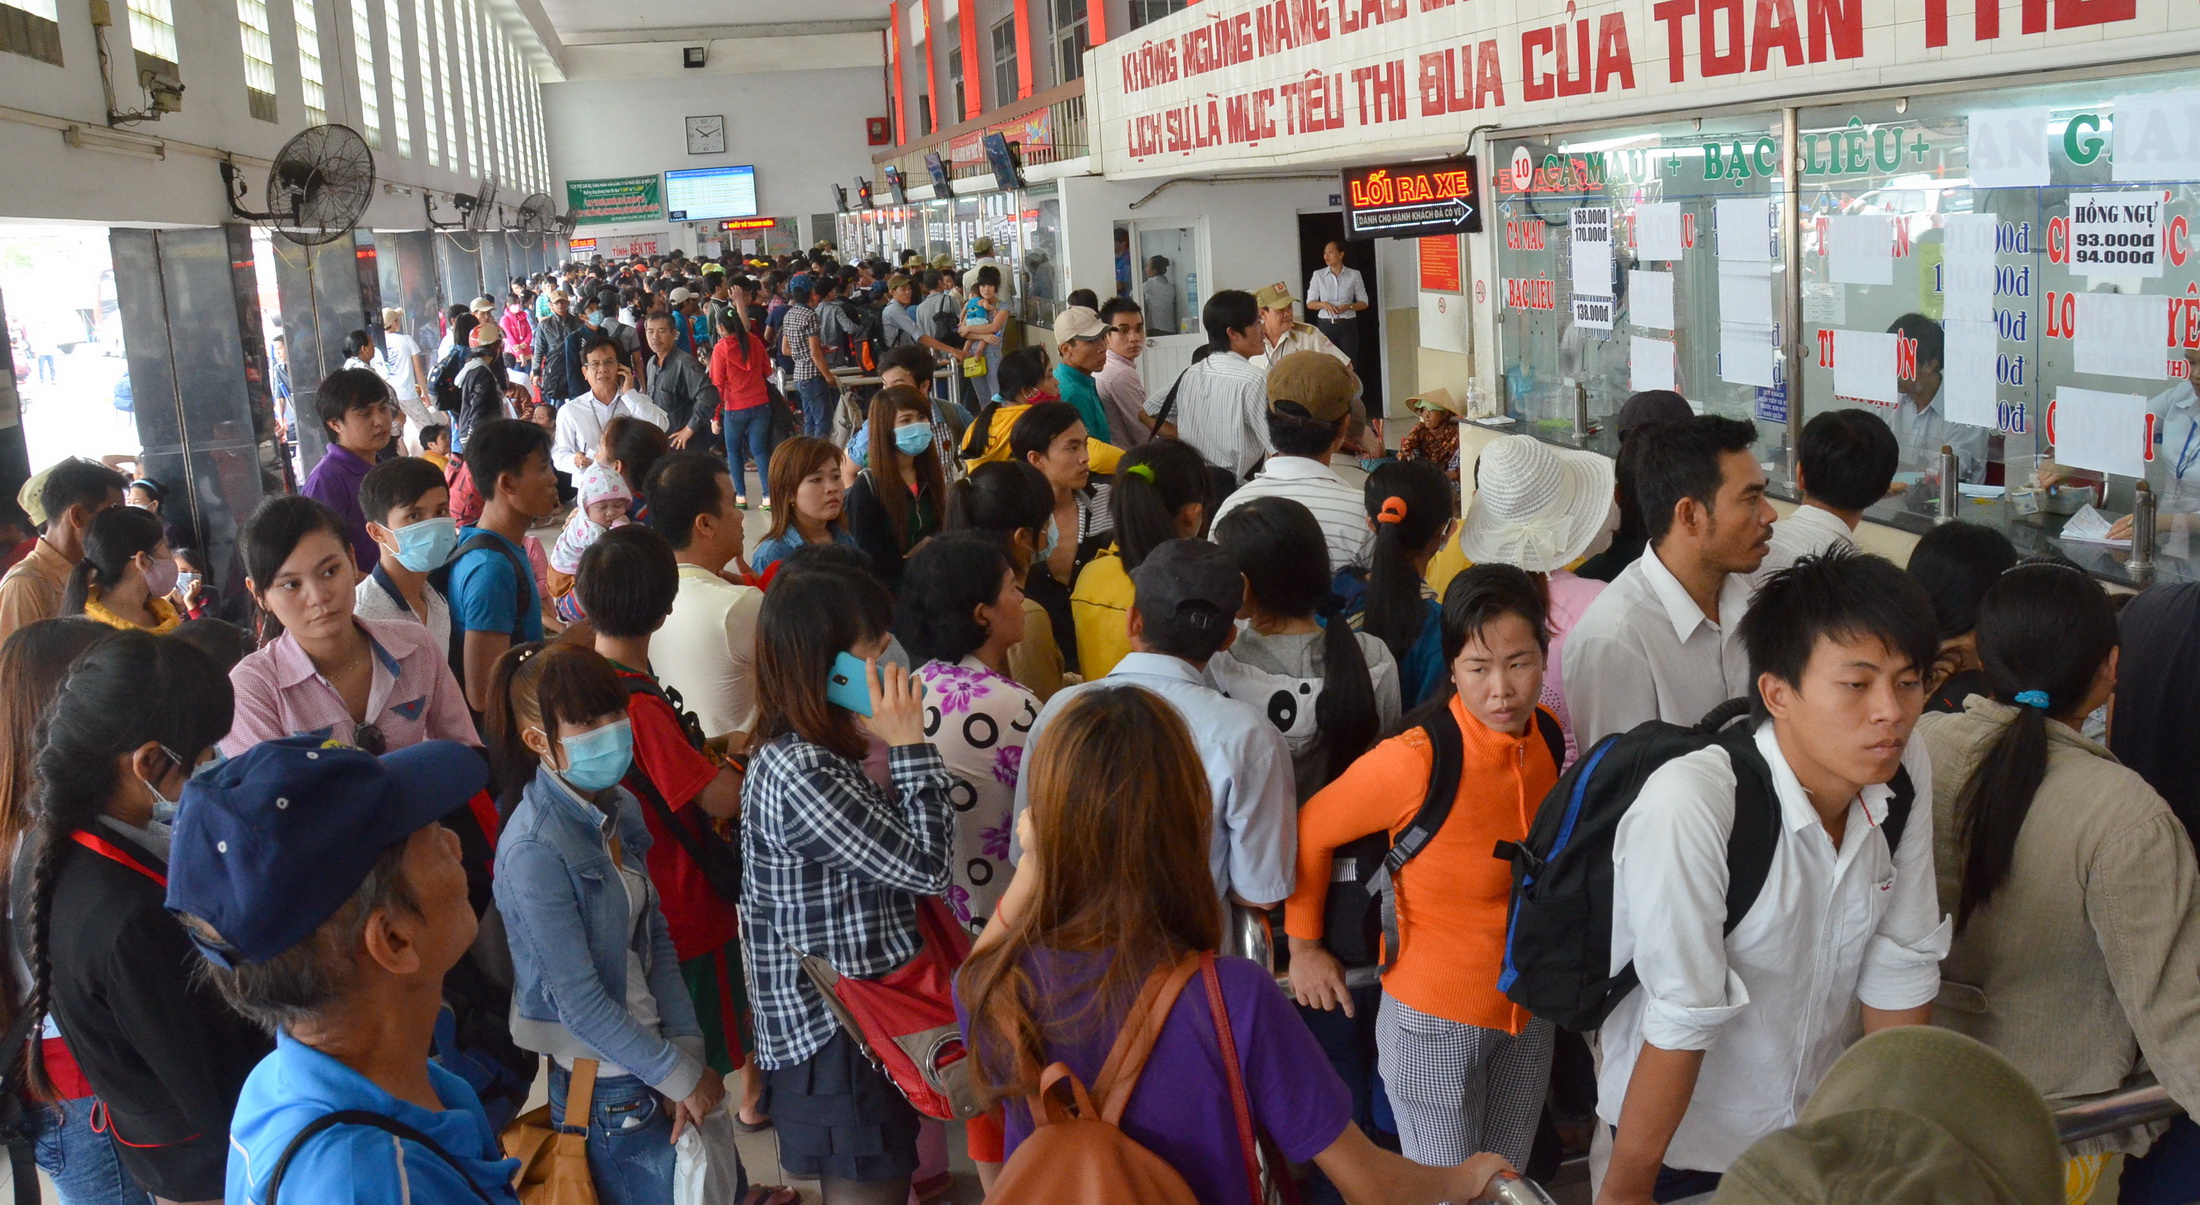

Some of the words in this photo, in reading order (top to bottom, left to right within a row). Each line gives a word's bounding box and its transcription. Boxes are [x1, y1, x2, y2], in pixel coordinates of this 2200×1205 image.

[1122, 40, 1178, 94] KHÔNG
[1181, 11, 1254, 78] NGỪNG
[1127, 112, 1163, 162] LỊCH
[1226, 88, 1276, 147] MỤC
[1280, 68, 1345, 135] TIÊU
[1351, 59, 1406, 125] THI
[1419, 38, 1505, 117] ĐUA
[1521, 0, 1635, 102] CỦA
[1584, 148, 1649, 186] MAU
[1702, 136, 1776, 187] BẠC
[1803, 115, 1904, 176] LIÊU
[1515, 158, 1529, 178] 10
[1352, 170, 1394, 206] LỐI
[1396, 175, 1434, 202] RA
[1433, 171, 1469, 198] XE
[1379, 213, 1392, 223] CHO
[1393, 210, 1411, 222] HÀNH
[1411, 208, 1434, 220] KHÁCH
[1574, 209, 1607, 225] 168.000đ
[2075, 197, 2118, 223] HỒNG
[2123, 201, 2158, 228] NGỰ
[1522, 219, 1545, 251] MAU
[1575, 226, 1607, 242] 170.000đ
[2076, 234, 2155, 247] 93.000đ
[644, 241, 657, 254] TRE
[2076, 250, 2155, 264] 94.000đ
[1508, 278, 1529, 314] BẠC
[1530, 270, 1555, 310] LIÊU
[1576, 303, 1609, 322] 138.000đ
